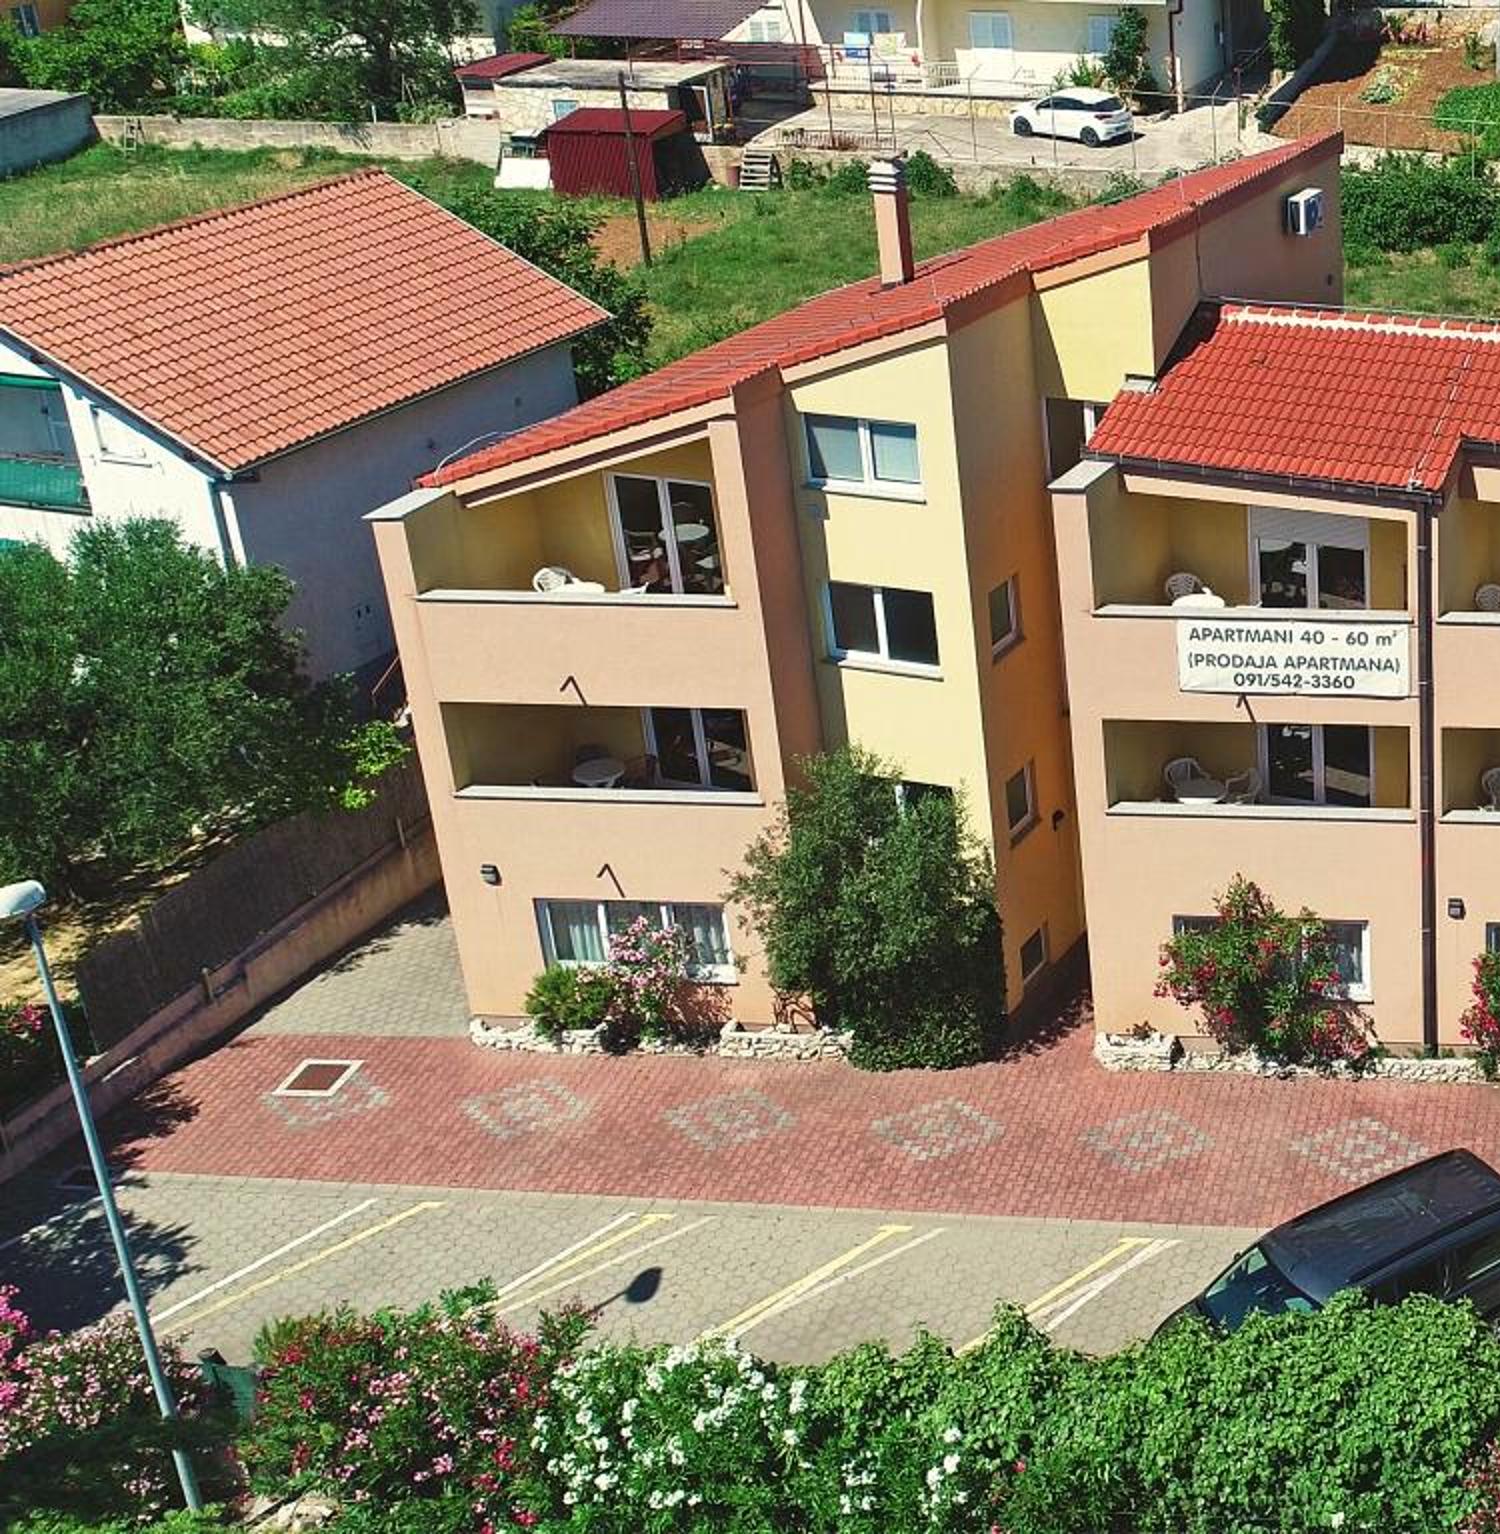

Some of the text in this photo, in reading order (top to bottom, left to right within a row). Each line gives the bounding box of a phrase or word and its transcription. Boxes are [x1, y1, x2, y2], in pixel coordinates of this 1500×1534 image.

[1189, 627, 1293, 644] APARTMANI
[1300, 630, 1325, 645] 40
[1345, 631, 1369, 646] 60
[1188, 652, 1401, 674] (PRODAJA APARTMANA)
[1233, 672, 1355, 689] 091/542-3360
